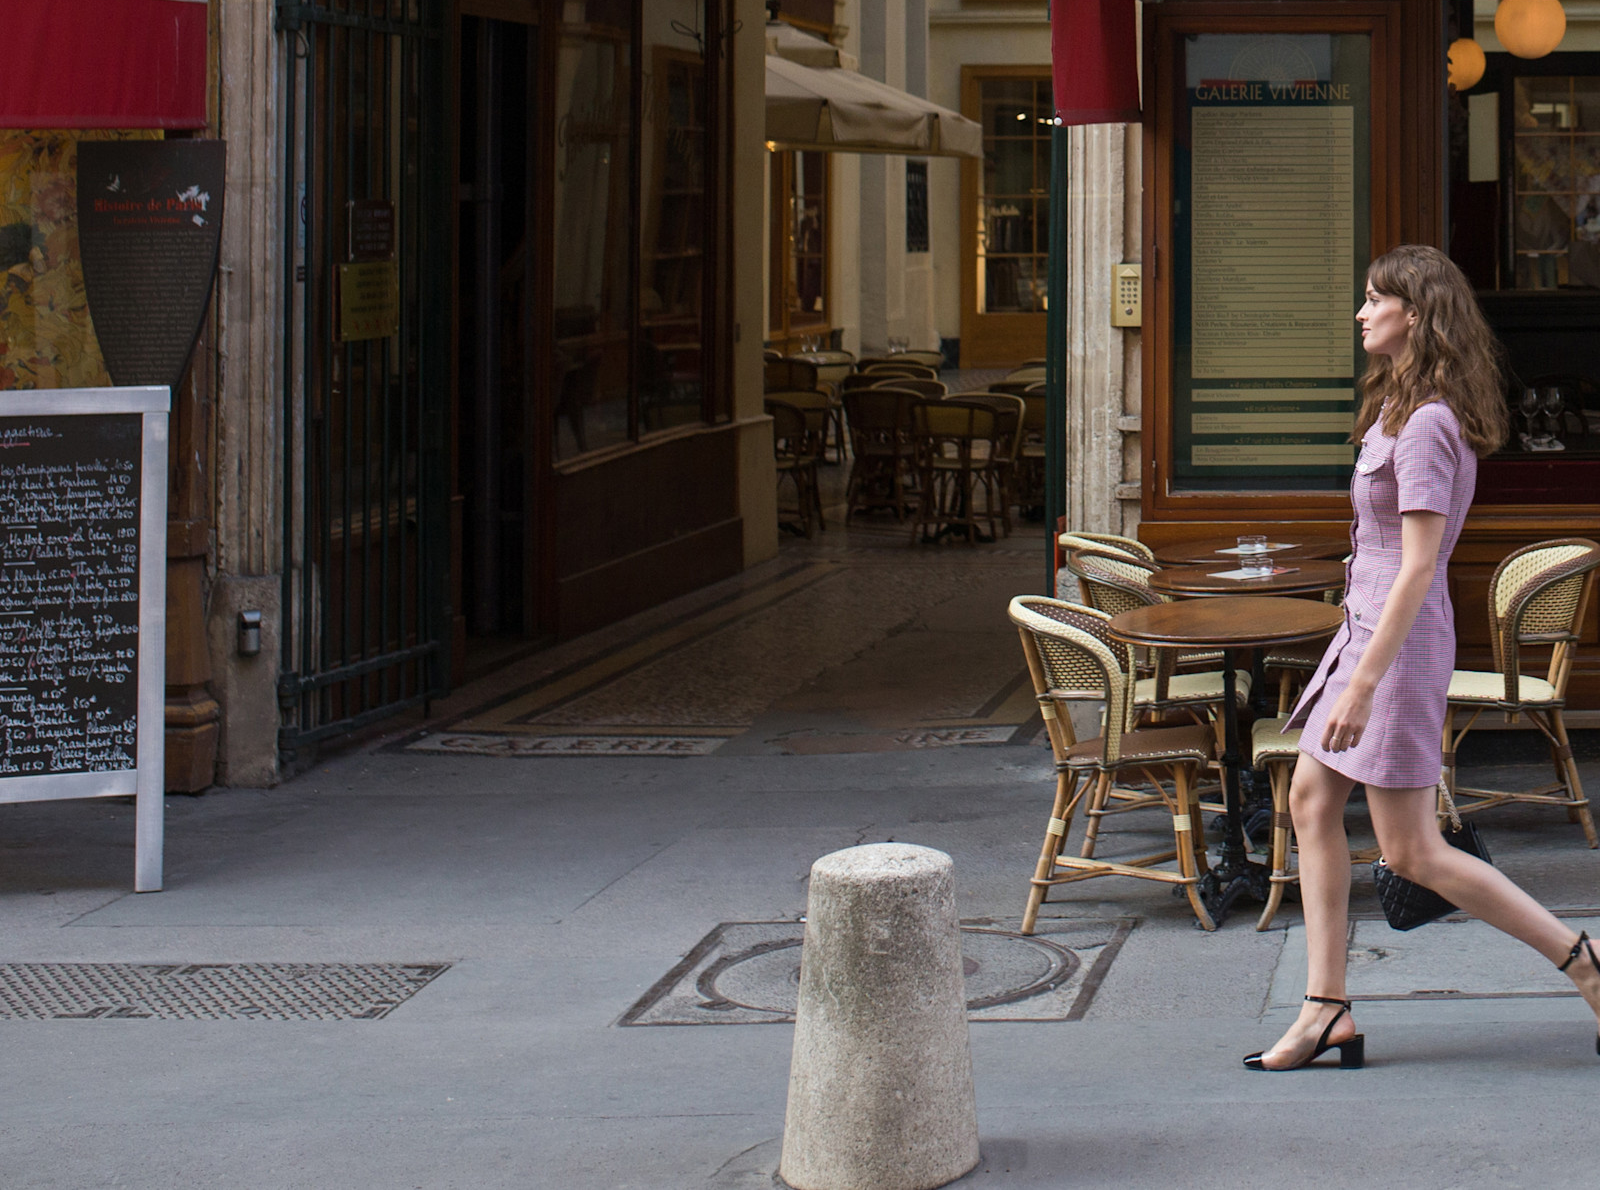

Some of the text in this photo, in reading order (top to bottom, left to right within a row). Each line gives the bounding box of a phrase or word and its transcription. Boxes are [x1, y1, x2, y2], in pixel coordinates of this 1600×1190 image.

[1195, 83, 1351, 100] GALERIE VIVIENNE
[95, 198, 143, 212] Histoire
[147, 198, 161, 212] de
